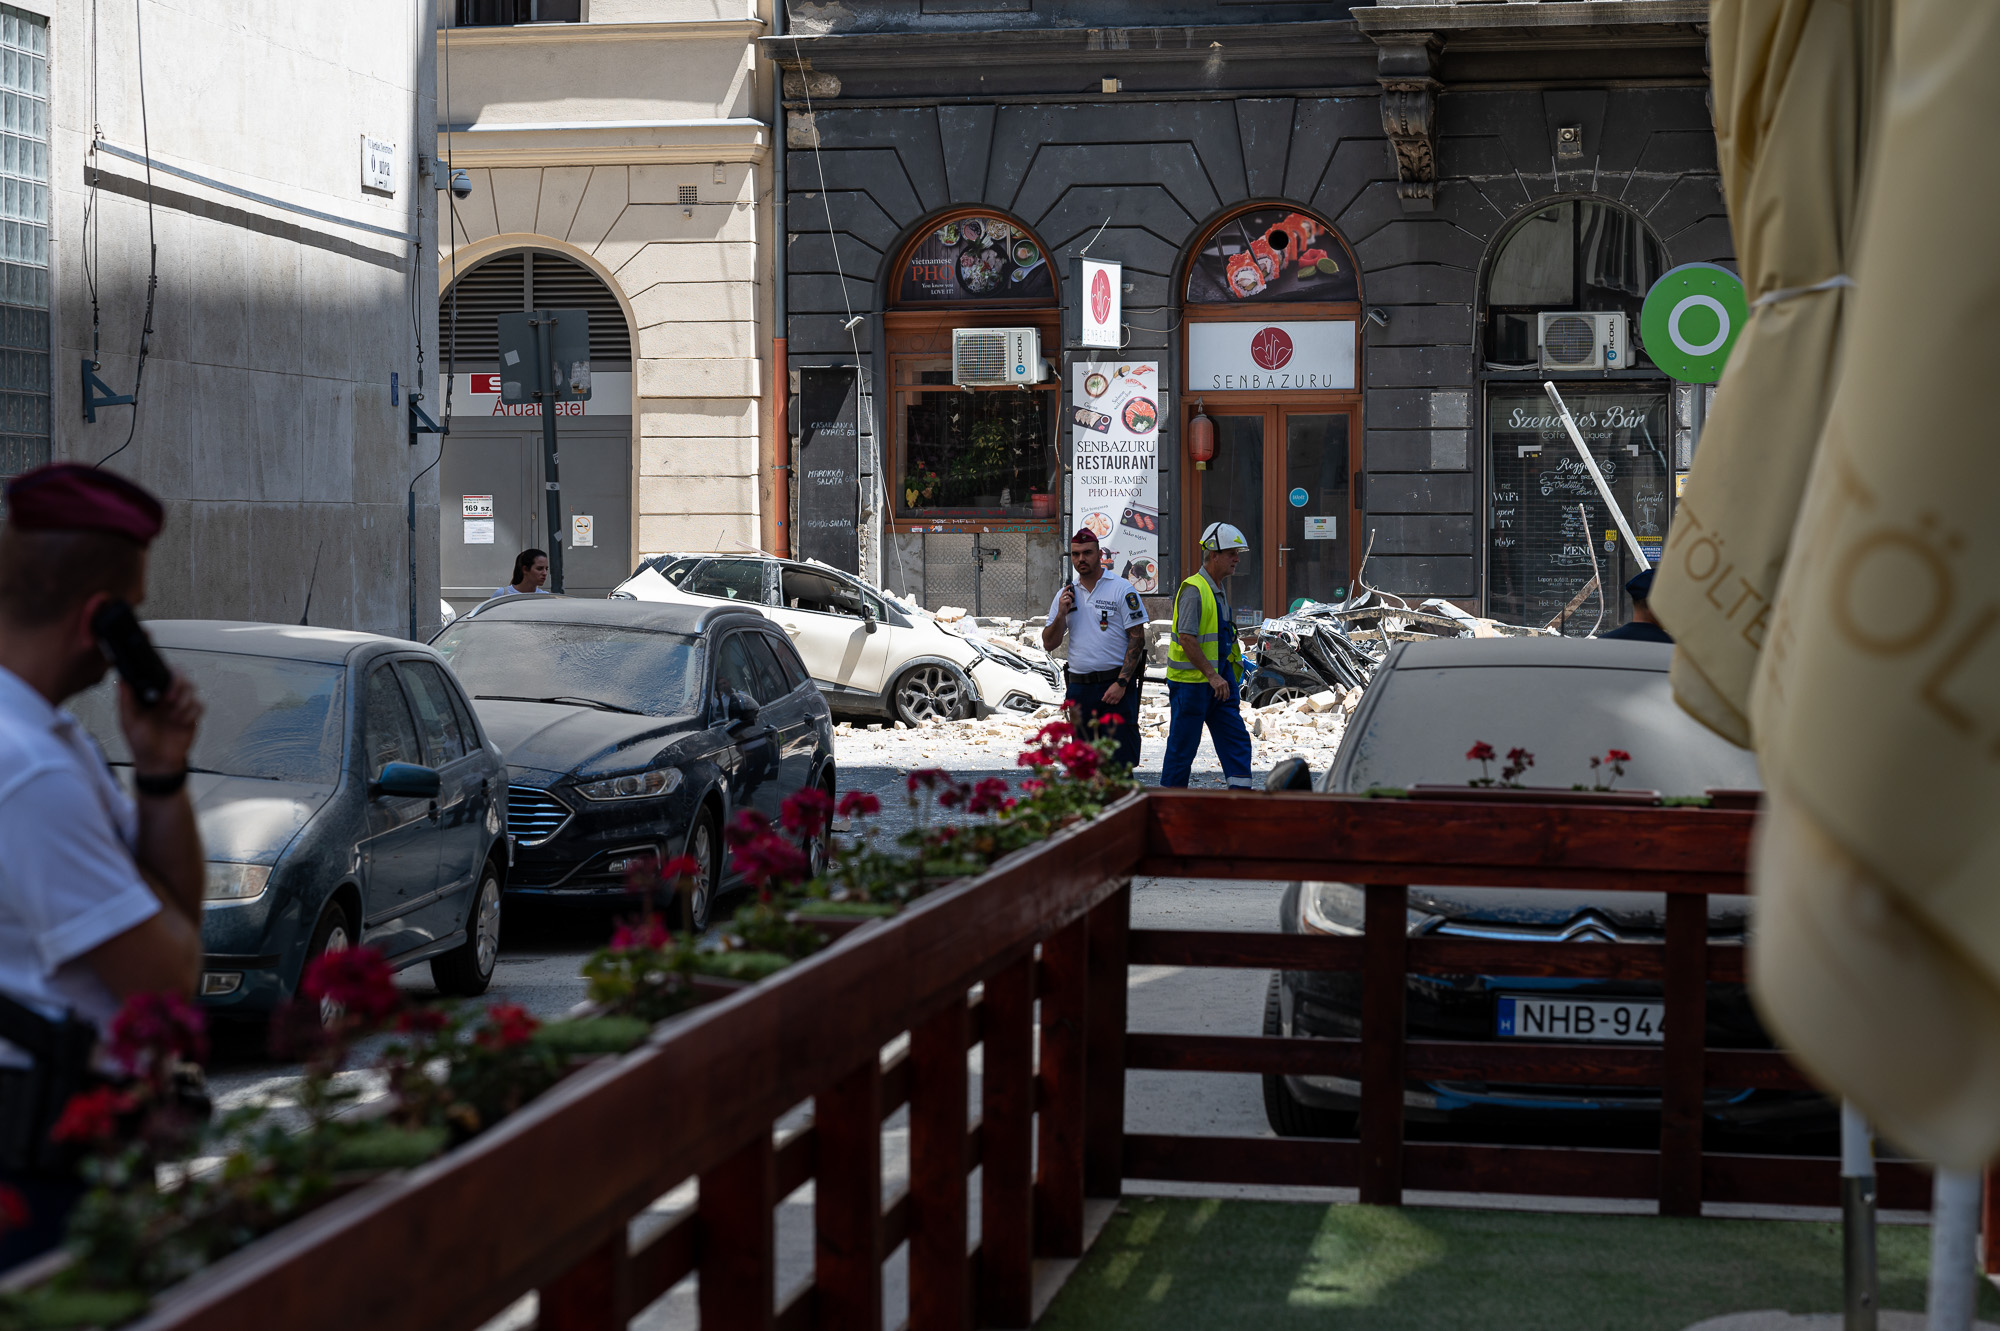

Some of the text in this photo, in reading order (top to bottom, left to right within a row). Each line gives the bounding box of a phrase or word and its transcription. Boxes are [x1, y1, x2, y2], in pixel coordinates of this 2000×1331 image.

[912, 265, 954, 281] PHO
[1212, 374, 1333, 389] SENBAZURU
[1602, 405, 1646, 429] Bár
[820, 429, 845, 437] GYROS
[1541, 431, 1614, 440] Coffe Liqueur
[1077, 441, 1155, 453] SENBAZURU
[1077, 456, 1155, 470] RESTAURANT
[1081, 476, 1107, 485] SUSHI
[1114, 476, 1148, 485] RAMEN
[1088, 488, 1142, 497] PHO HANOI
[1493, 492, 1519, 501] WiFi
[1500, 520, 1513, 528] TV
